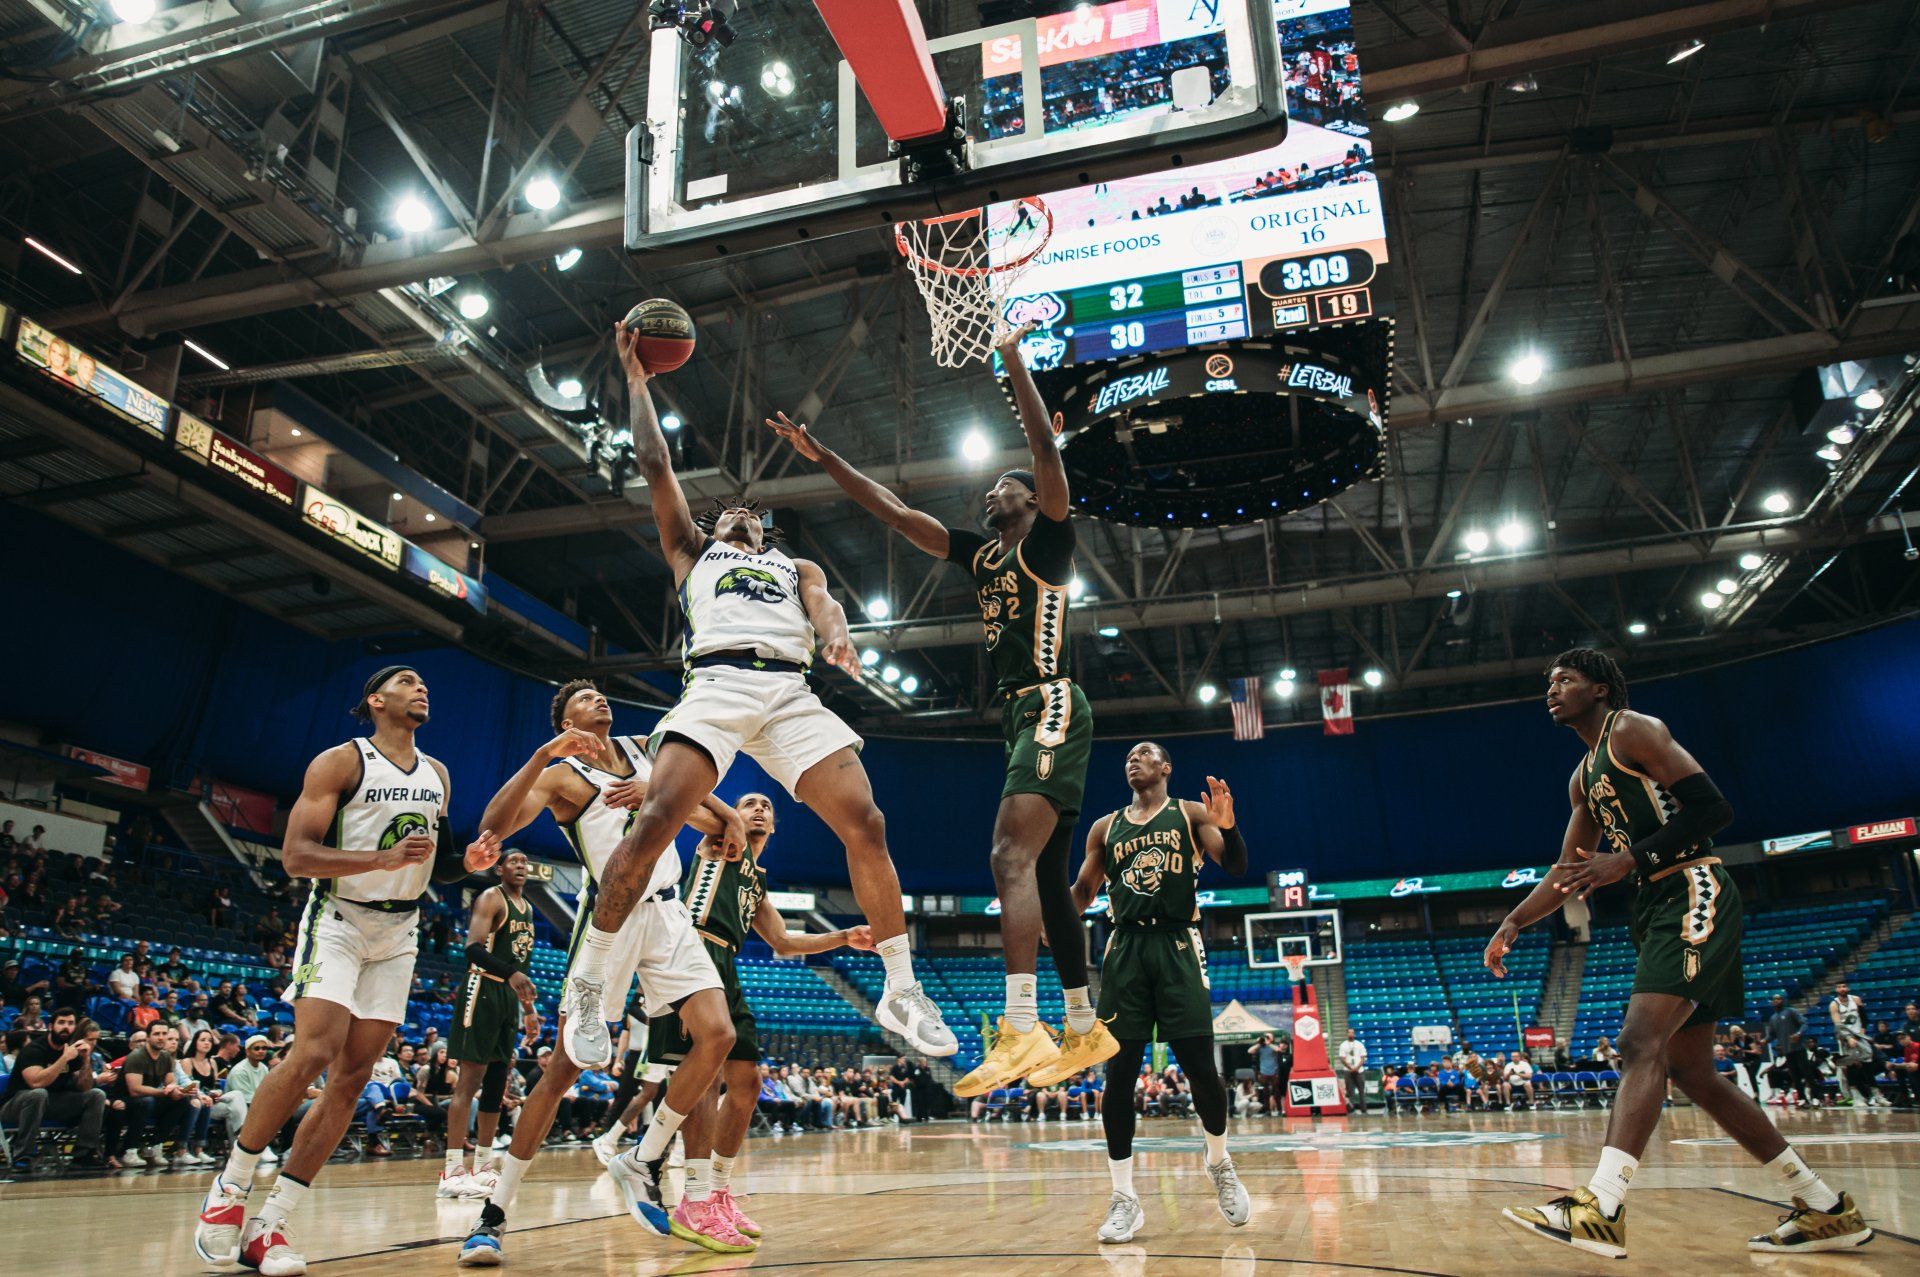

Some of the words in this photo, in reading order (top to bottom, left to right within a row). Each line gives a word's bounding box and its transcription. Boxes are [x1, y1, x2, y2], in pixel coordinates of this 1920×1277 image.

[1250, 199, 1371, 232] ORIGINAL
[1103, 233, 1161, 255] FOODS
[1301, 223, 1325, 245] 16
[1213, 270, 1221, 280] 5
[1282, 255, 1350, 290] 3:09
[1109, 283, 1144, 311] 32
[1216, 286, 1222, 296] 0
[1271, 296, 1307, 307] QUARTER
[1218, 308, 1225, 318] 5
[1276, 306, 1306, 325] 2nd
[1328, 294, 1358, 317] 19
[1110, 322, 1145, 350] 30
[1219, 325, 1226, 335] 2
[1205, 380, 1238, 392] CEBL
[213, 439, 265, 478] Saskatoon
[704, 551, 753, 562] RIVER
[364, 787, 409, 803] RIVER
[412, 788, 441, 805] LIONS
[1610, 799, 1629, 823] 7
[1856, 820, 1906, 839] FLAMAN
[1113, 828, 1181, 864] RATTLERS
[1163, 851, 1183, 874] 10
[1285, 886, 1303, 908] 19
